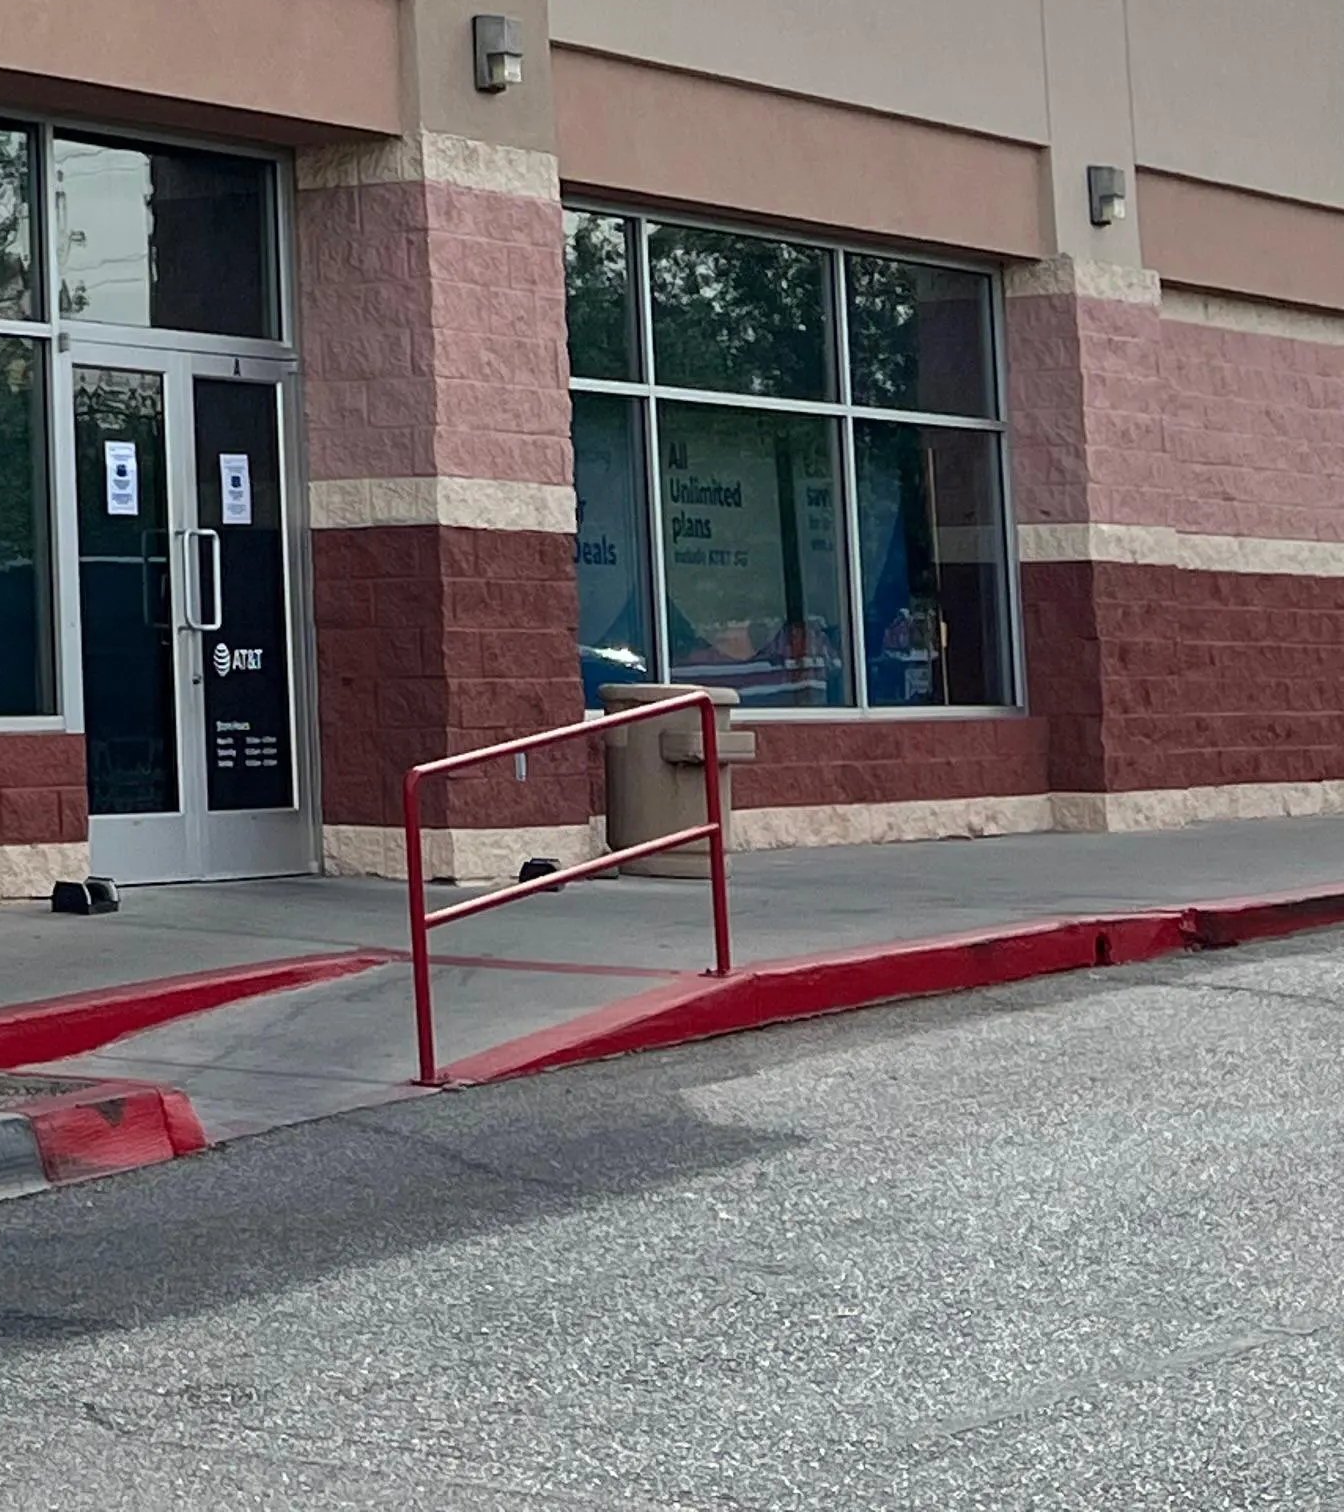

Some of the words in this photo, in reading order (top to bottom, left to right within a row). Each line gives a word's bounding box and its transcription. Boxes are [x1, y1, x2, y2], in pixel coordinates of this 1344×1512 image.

[668, 441, 688, 470] All
[669, 475, 743, 508] Unlimited
[671, 510, 712, 544] plans
[232, 649, 263, 670] AT&T
